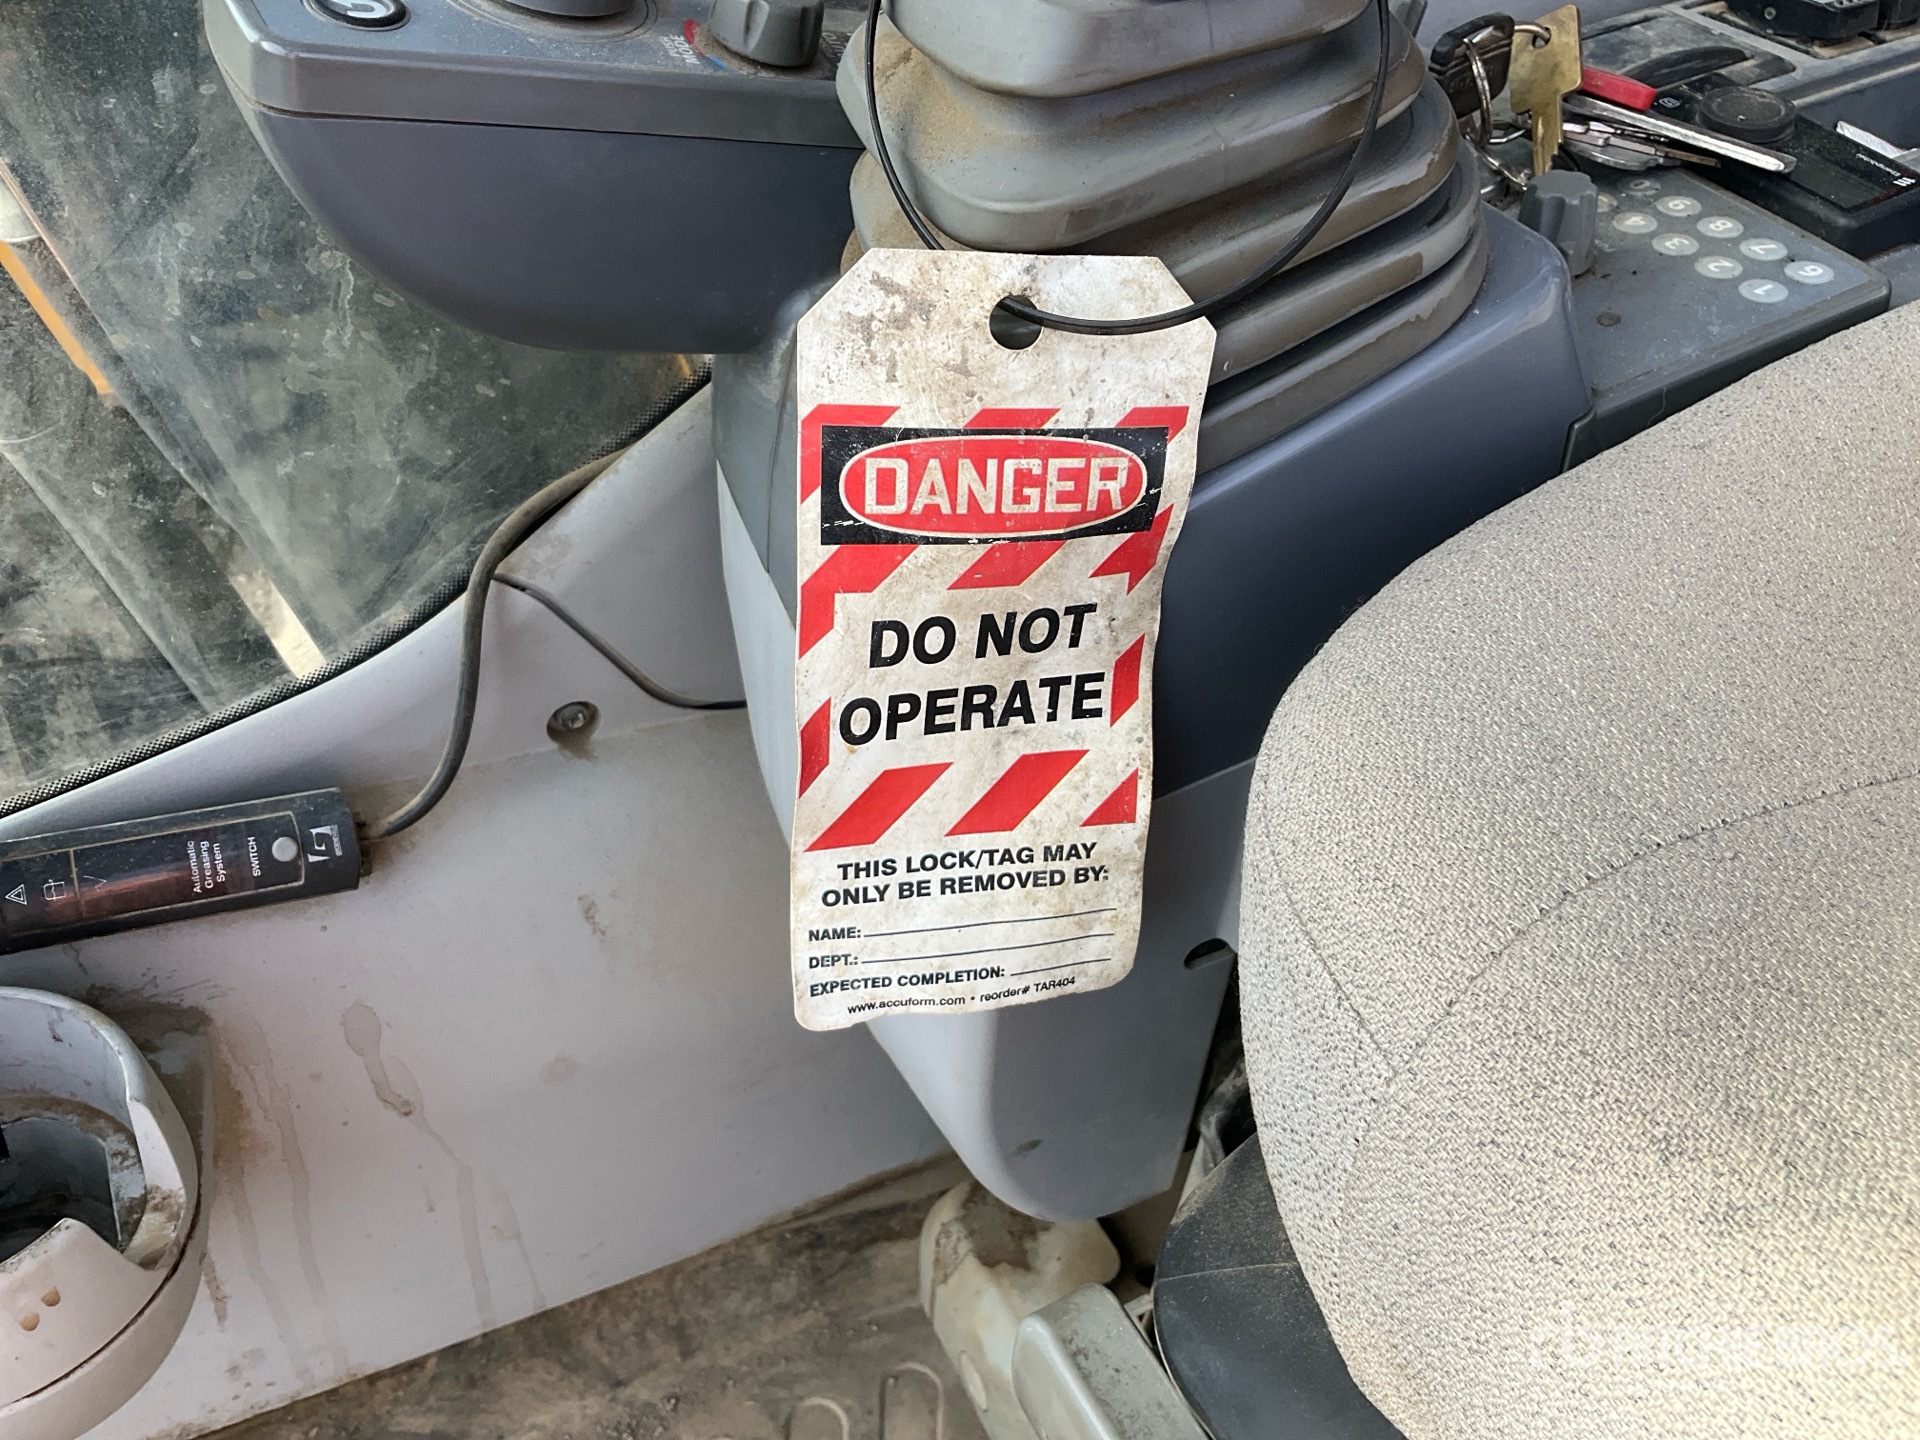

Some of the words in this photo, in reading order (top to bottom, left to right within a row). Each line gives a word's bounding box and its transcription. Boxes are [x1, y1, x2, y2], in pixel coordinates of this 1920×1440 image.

[669, 34, 700, 64] MODE
[1668, 200, 1692, 211] 9
[1624, 216, 1646, 226] 4
[1709, 219, 1733, 231] 8
[1664, 237, 1690, 249] 3
[1707, 259, 1734, 272] 2
[1798, 265, 1824, 277] 6
[1753, 284, 1774, 295] 1
[864, 457, 1130, 515] DANGER
[869, 616, 956, 668] DO
[975, 603, 1097, 659] NOT
[839, 671, 1105, 746] OPERATE
[186, 840, 202, 893] Automatic
[200, 841, 214, 889] Greasing
[213, 843, 226, 883] System
[247, 836, 262, 877] SWITCH
[837, 858, 897, 881] THIS
[906, 846, 1035, 874] LOCK/TAG
[1043, 842, 1098, 863] MAY
[821, 884, 890, 907] ONLY
[899, 880, 932, 900] BE
[940, 869, 1066, 895] REMOVED
[1074, 865, 1109, 884] BY:
[808, 927, 861, 942] NAME:
[808, 954, 859, 969] DEPT.:
[809, 976, 893, 997] EXPECTED
[899, 967, 1006, 987] COMPLETION:
[847, 995, 966, 1014] www.accuform.com
[980, 983, 1031, 1003] reorder#
[1034, 976, 1077, 993] TAR404
